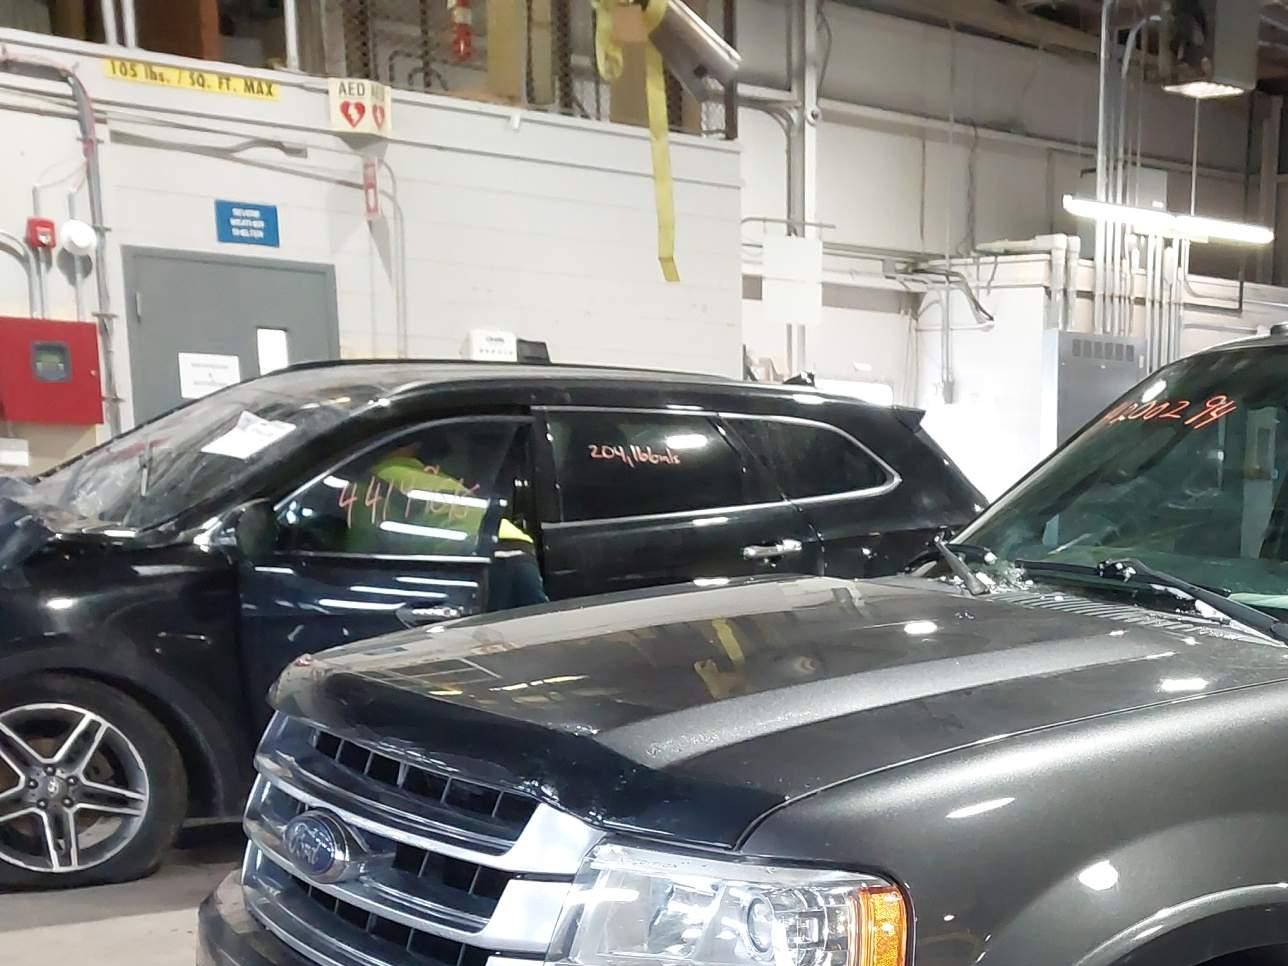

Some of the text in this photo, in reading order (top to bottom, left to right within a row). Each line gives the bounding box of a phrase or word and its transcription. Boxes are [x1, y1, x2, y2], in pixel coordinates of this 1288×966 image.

[110, 60, 138, 79] 105
[144, 64, 172, 84] lbs.
[189, 72, 211, 89] SQ.
[218, 76, 237, 93] FT.
[243, 79, 274, 97] MAX
[338, 81, 366, 97] AED
[288, 821, 327, 865] Ford
